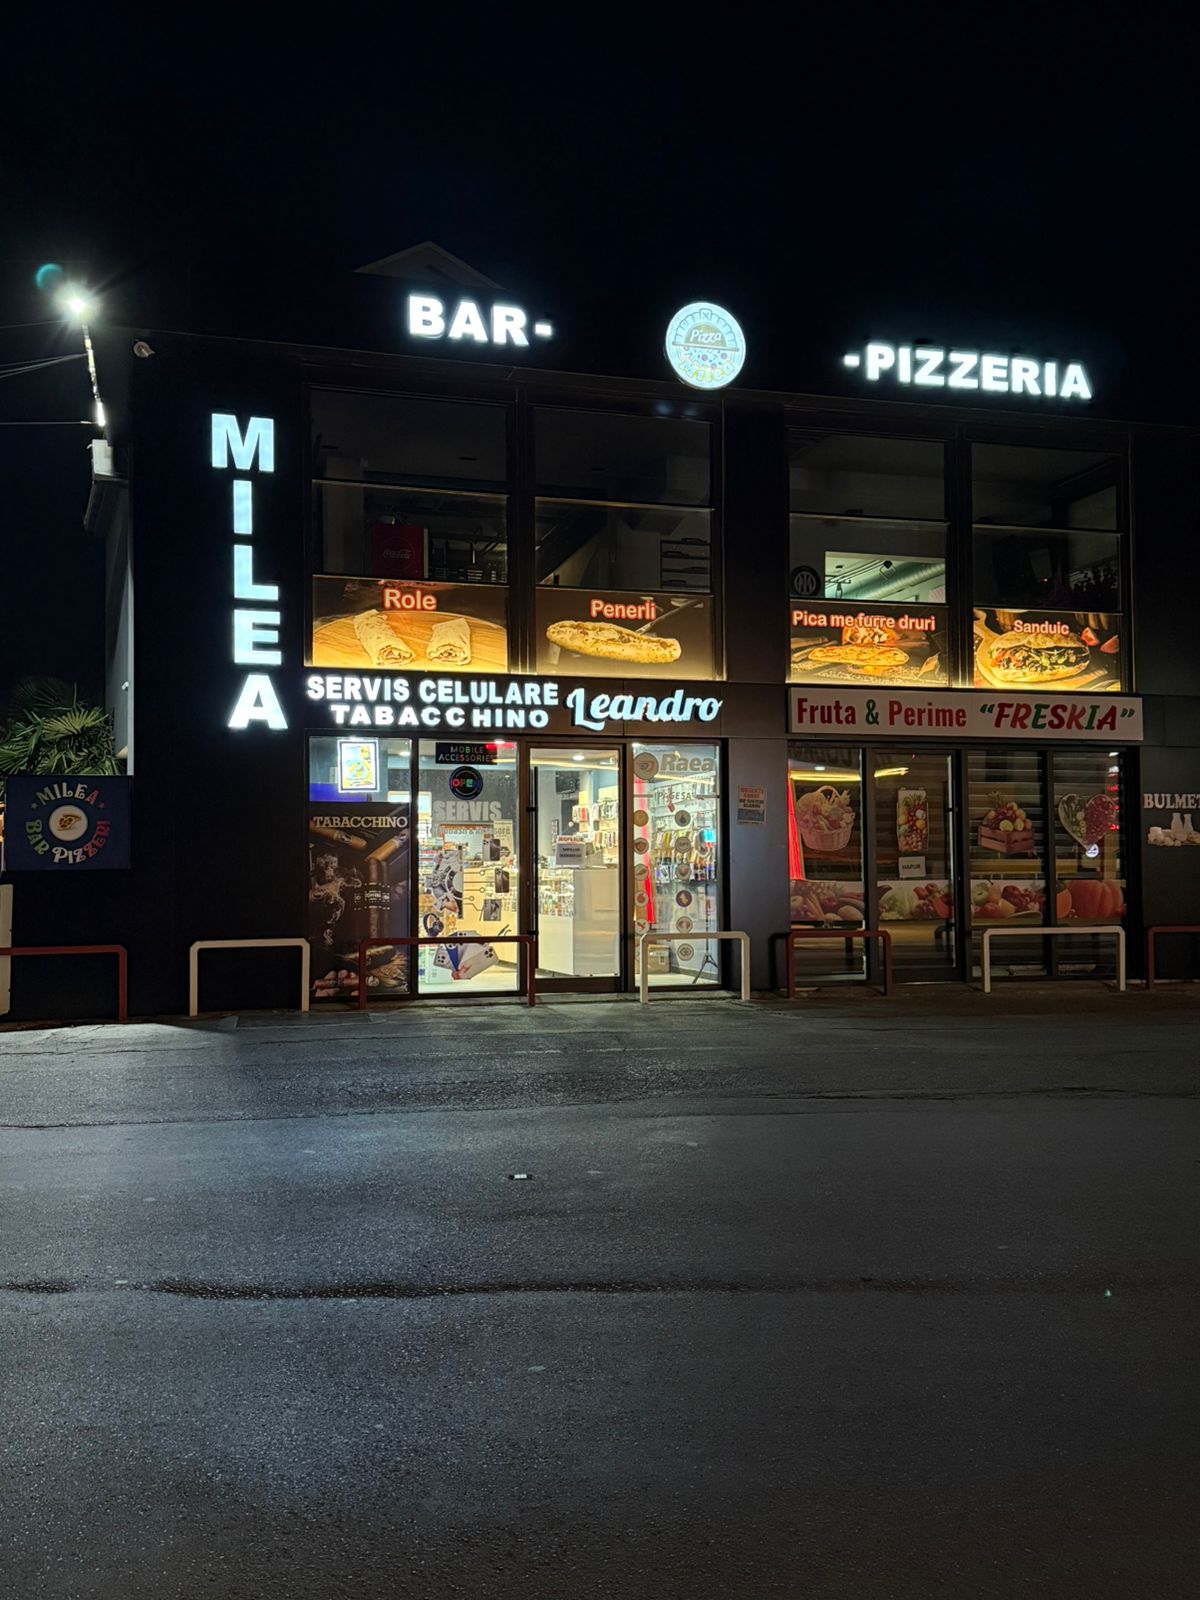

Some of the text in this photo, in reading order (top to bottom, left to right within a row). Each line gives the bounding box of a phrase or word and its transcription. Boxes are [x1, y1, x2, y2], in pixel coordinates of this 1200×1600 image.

[409, 294, 552, 347] BAR-
[690, 329, 722, 343] Pizza
[210, 412, 289, 731] MILEA
[383, 588, 437, 611] Role
[792, 609, 936, 632] Pica me furre druri
[1012, 619, 1070, 636] Sanduic
[306, 675, 559, 706] SERVIS CELULARE
[330, 704, 550, 729] TABACCHINO
[566, 687, 723, 731] Leandro
[796, 697, 857, 726] Fruta
[864, 699, 880, 726] &
[887, 700, 967, 728] Perime
[438, 753, 496, 762] ACCESSORIES
[661, 751, 715, 772] Raea
[36, 782, 99, 806] MILEA
[452, 778, 481, 788] OPEN
[313, 816, 408, 828] TABACCHINO
[432, 800, 502, 821] SERVIS
[25, 819, 50, 855] BAR
